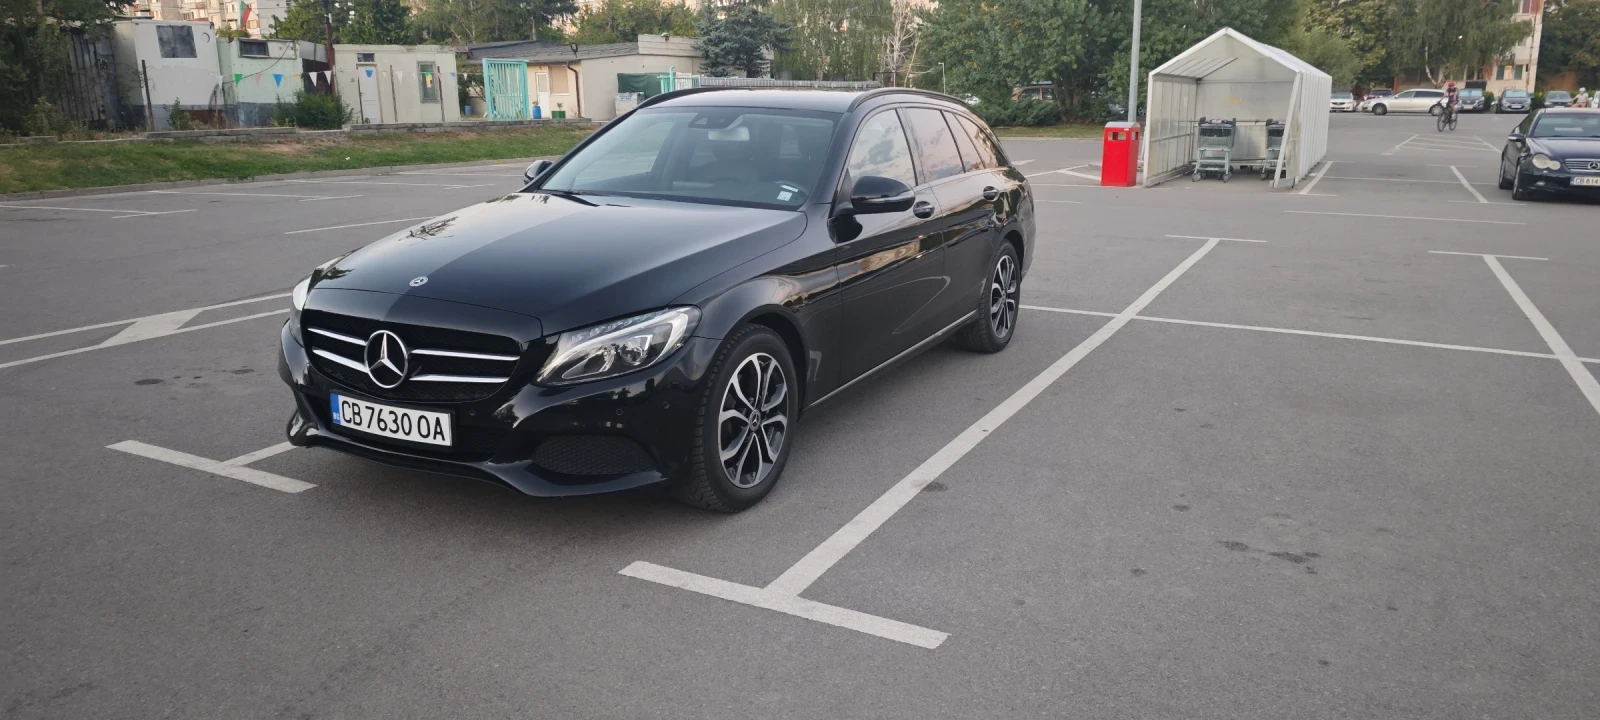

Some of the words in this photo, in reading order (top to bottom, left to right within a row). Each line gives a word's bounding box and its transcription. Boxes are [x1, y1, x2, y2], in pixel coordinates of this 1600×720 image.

[341, 400, 362, 426] CB
[365, 405, 412, 436] 7630
[417, 415, 446, 441] OA
